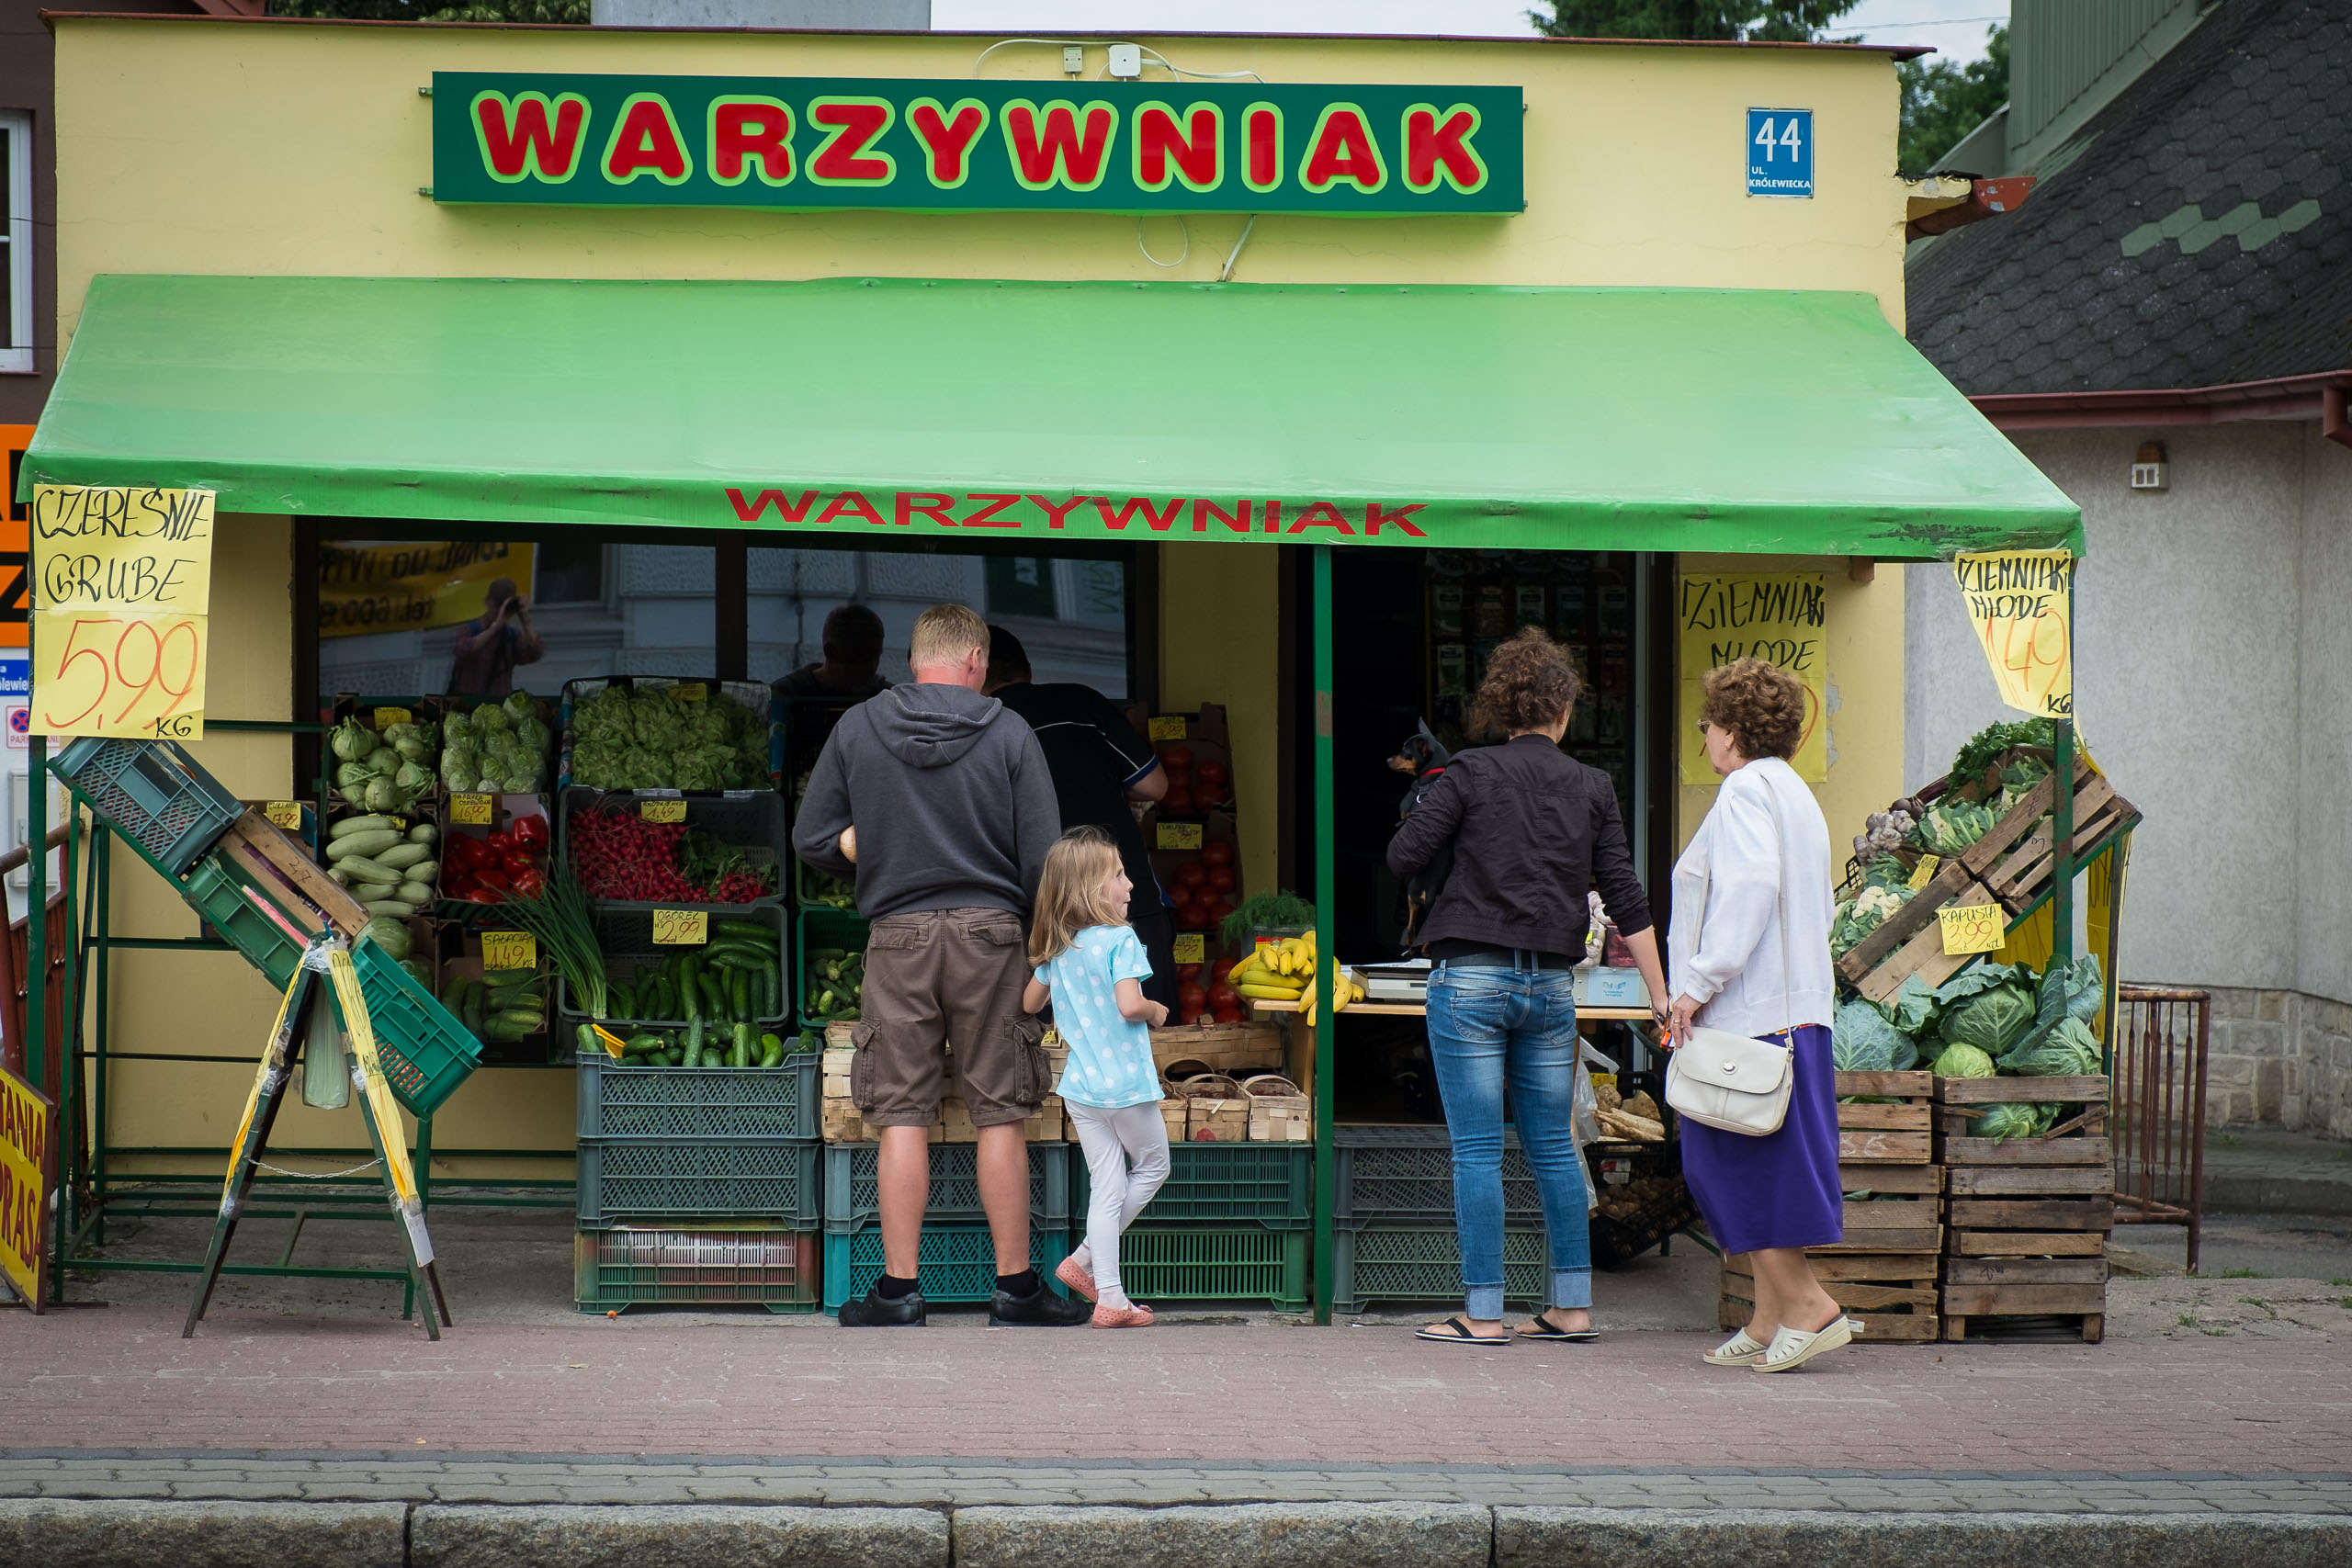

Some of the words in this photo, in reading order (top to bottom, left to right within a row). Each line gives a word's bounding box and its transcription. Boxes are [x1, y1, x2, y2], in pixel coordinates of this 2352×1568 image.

[470, 90, 1488, 194] WARZYWNIAK
[1755, 117, 1802, 162] 44
[1749, 177, 1811, 188] KRÓLEWIECKA
[1751, 166, 1768, 175] UL.
[36, 488, 213, 541] CZEREŚNIE
[724, 488, 1429, 536] WARZYWNIAK
[44, 553, 197, 604] GRUBE
[155, 715, 193, 739] KG
[1941, 905, 1996, 925] KAPUSTA
